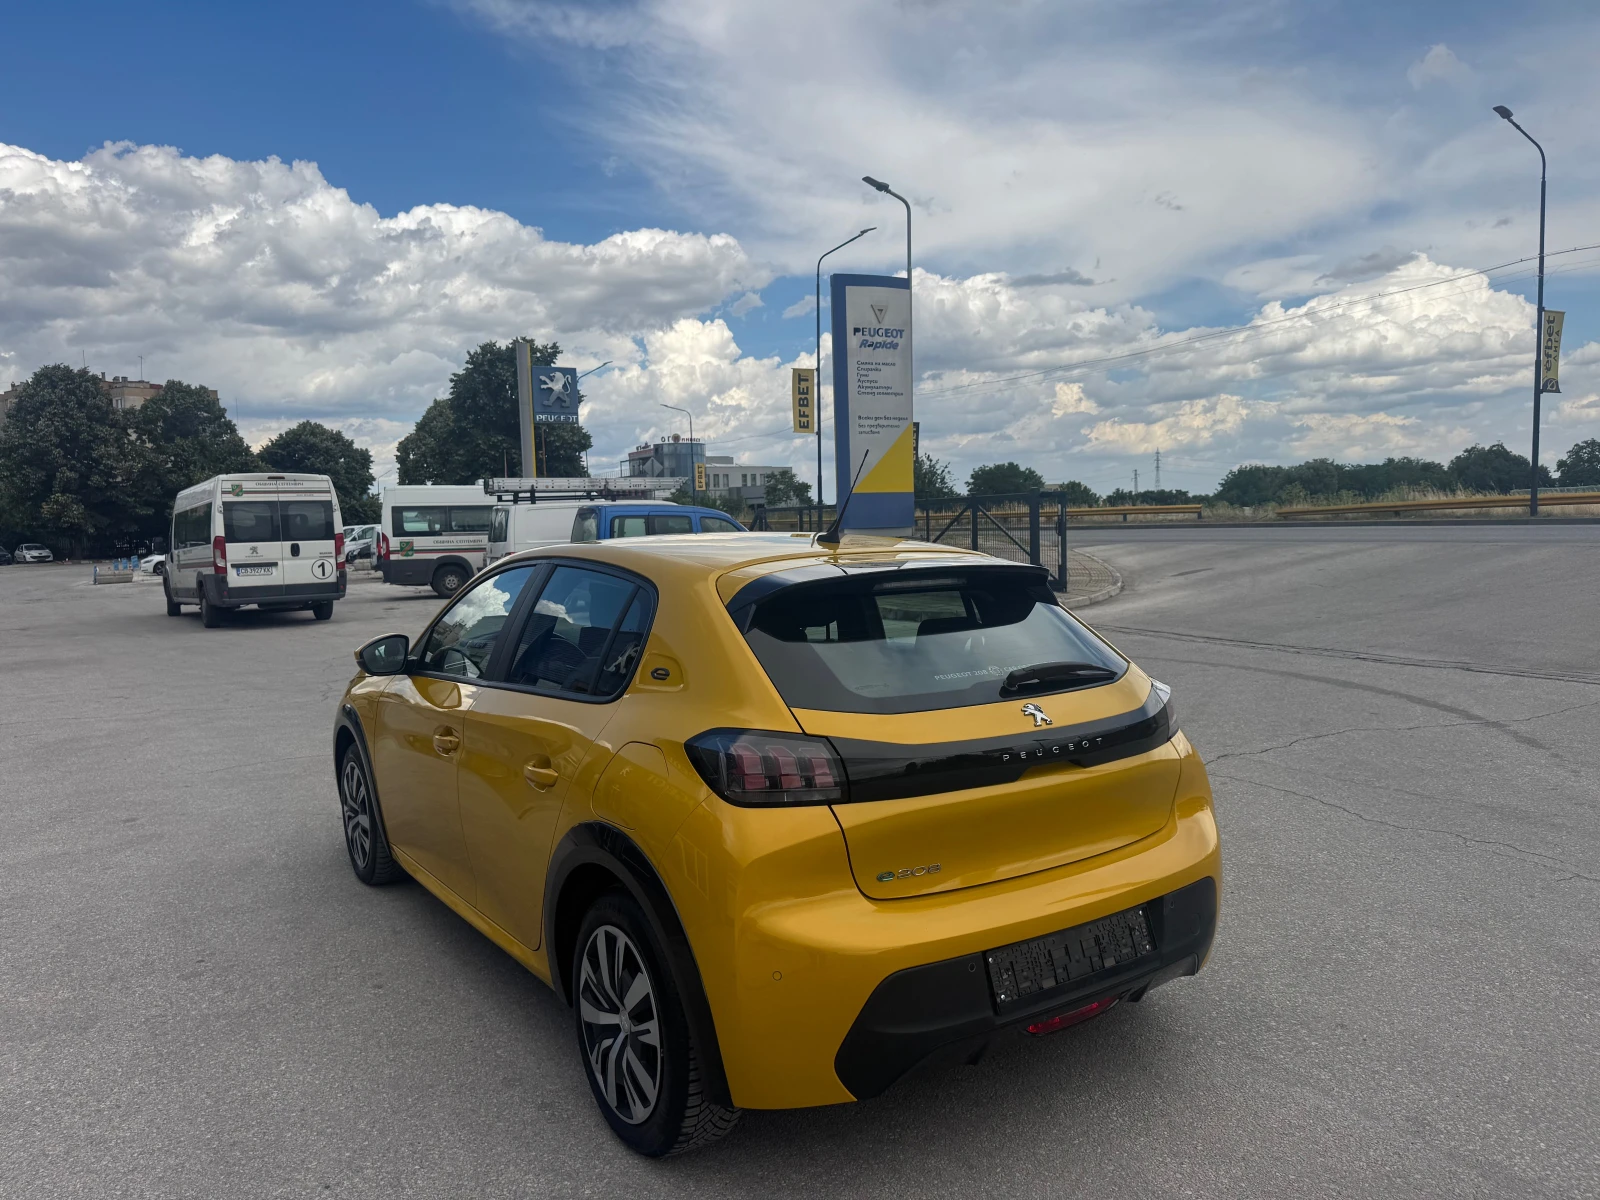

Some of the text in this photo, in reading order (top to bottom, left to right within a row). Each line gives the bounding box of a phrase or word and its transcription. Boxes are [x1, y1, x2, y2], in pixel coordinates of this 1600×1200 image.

[853, 327, 905, 339] PEUGEOT
[859, 339, 899, 350] Rapide
[1545, 315, 1556, 371] efbet
[797, 373, 810, 429] EFBET
[536, 414, 578, 422] PEUGEOT
[317, 562, 326, 577] 1
[934, 671, 972, 680] PEUGEOT
[1002, 737, 1102, 761] PEUGEOT
